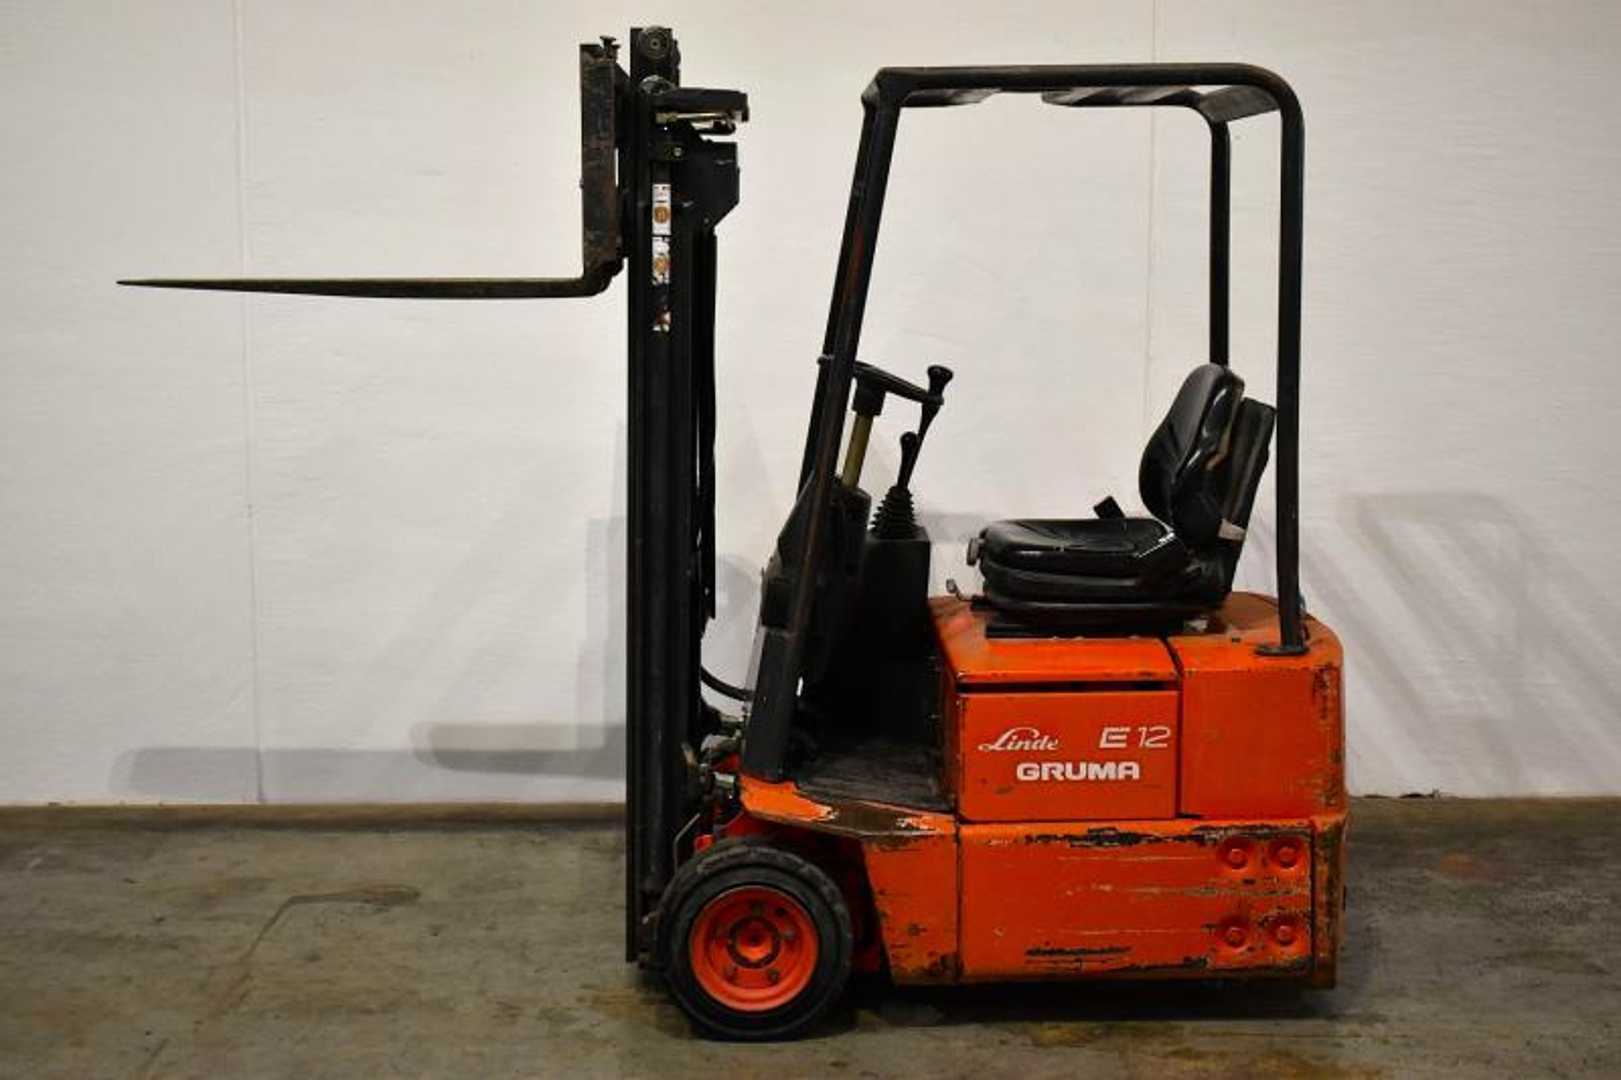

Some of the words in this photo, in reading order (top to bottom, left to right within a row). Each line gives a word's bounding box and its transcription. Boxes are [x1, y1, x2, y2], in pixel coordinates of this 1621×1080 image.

[978, 726, 1059, 751] Linde
[1100, 727, 1131, 748] E
[1138, 726, 1171, 748] 12
[1016, 761, 1140, 781] GRUMA
